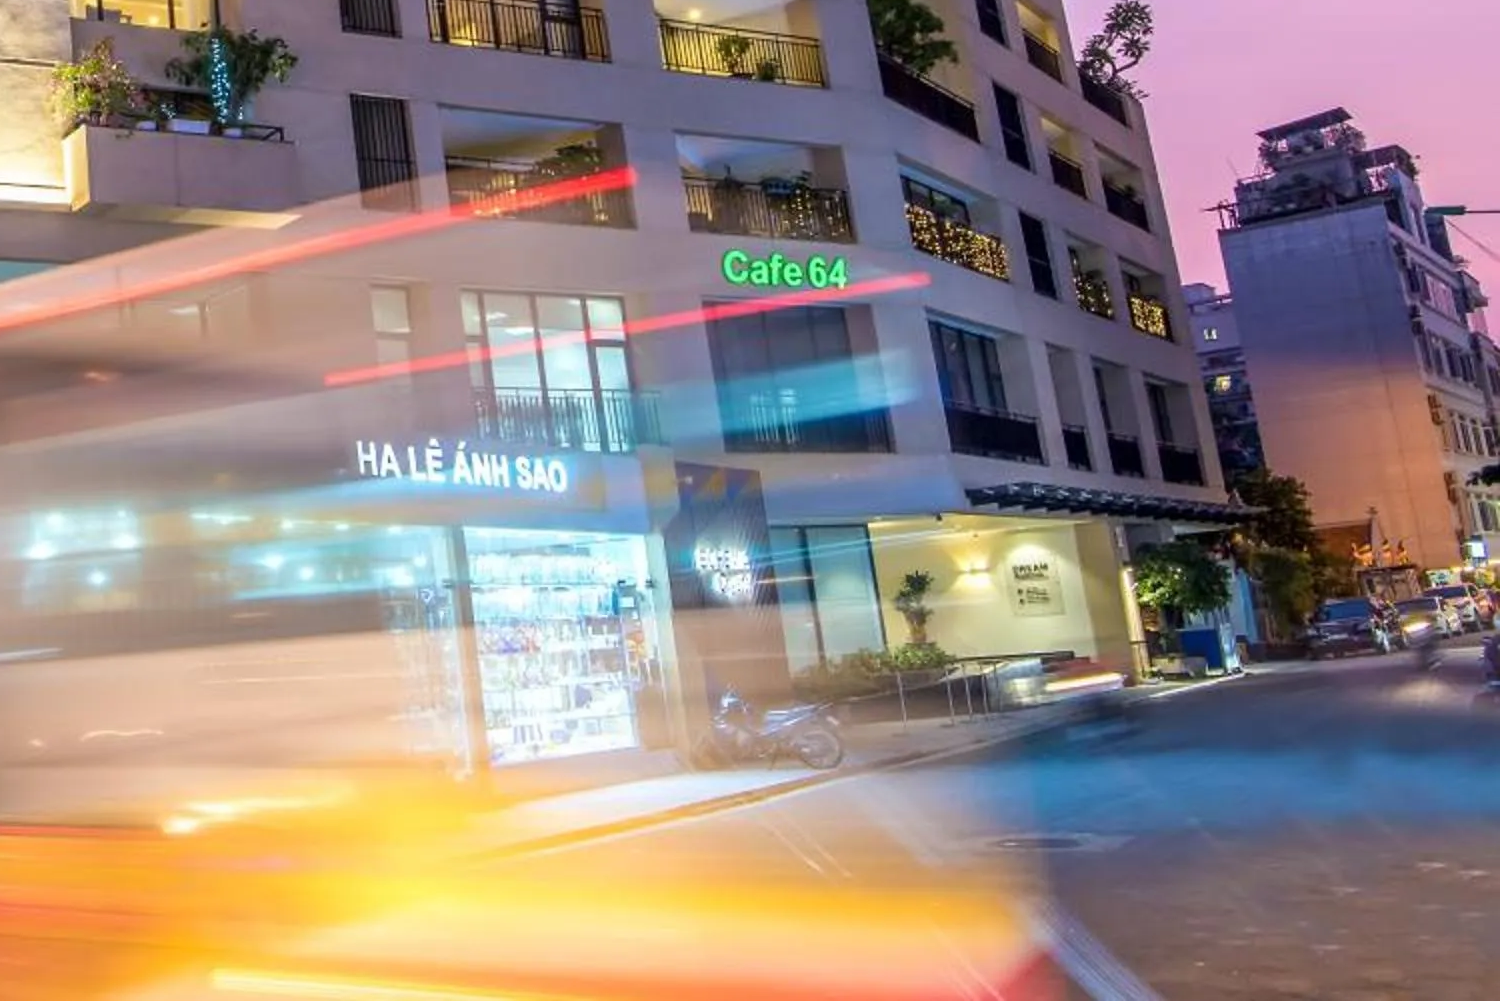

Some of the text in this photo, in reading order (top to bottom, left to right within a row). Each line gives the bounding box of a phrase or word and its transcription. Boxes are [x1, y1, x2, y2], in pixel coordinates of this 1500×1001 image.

[722, 249, 848, 290] Cafe 64
[406, 437, 447, 484] LÊ
[452, 440, 511, 488] ÁNH
[514, 455, 569, 494] SAO
